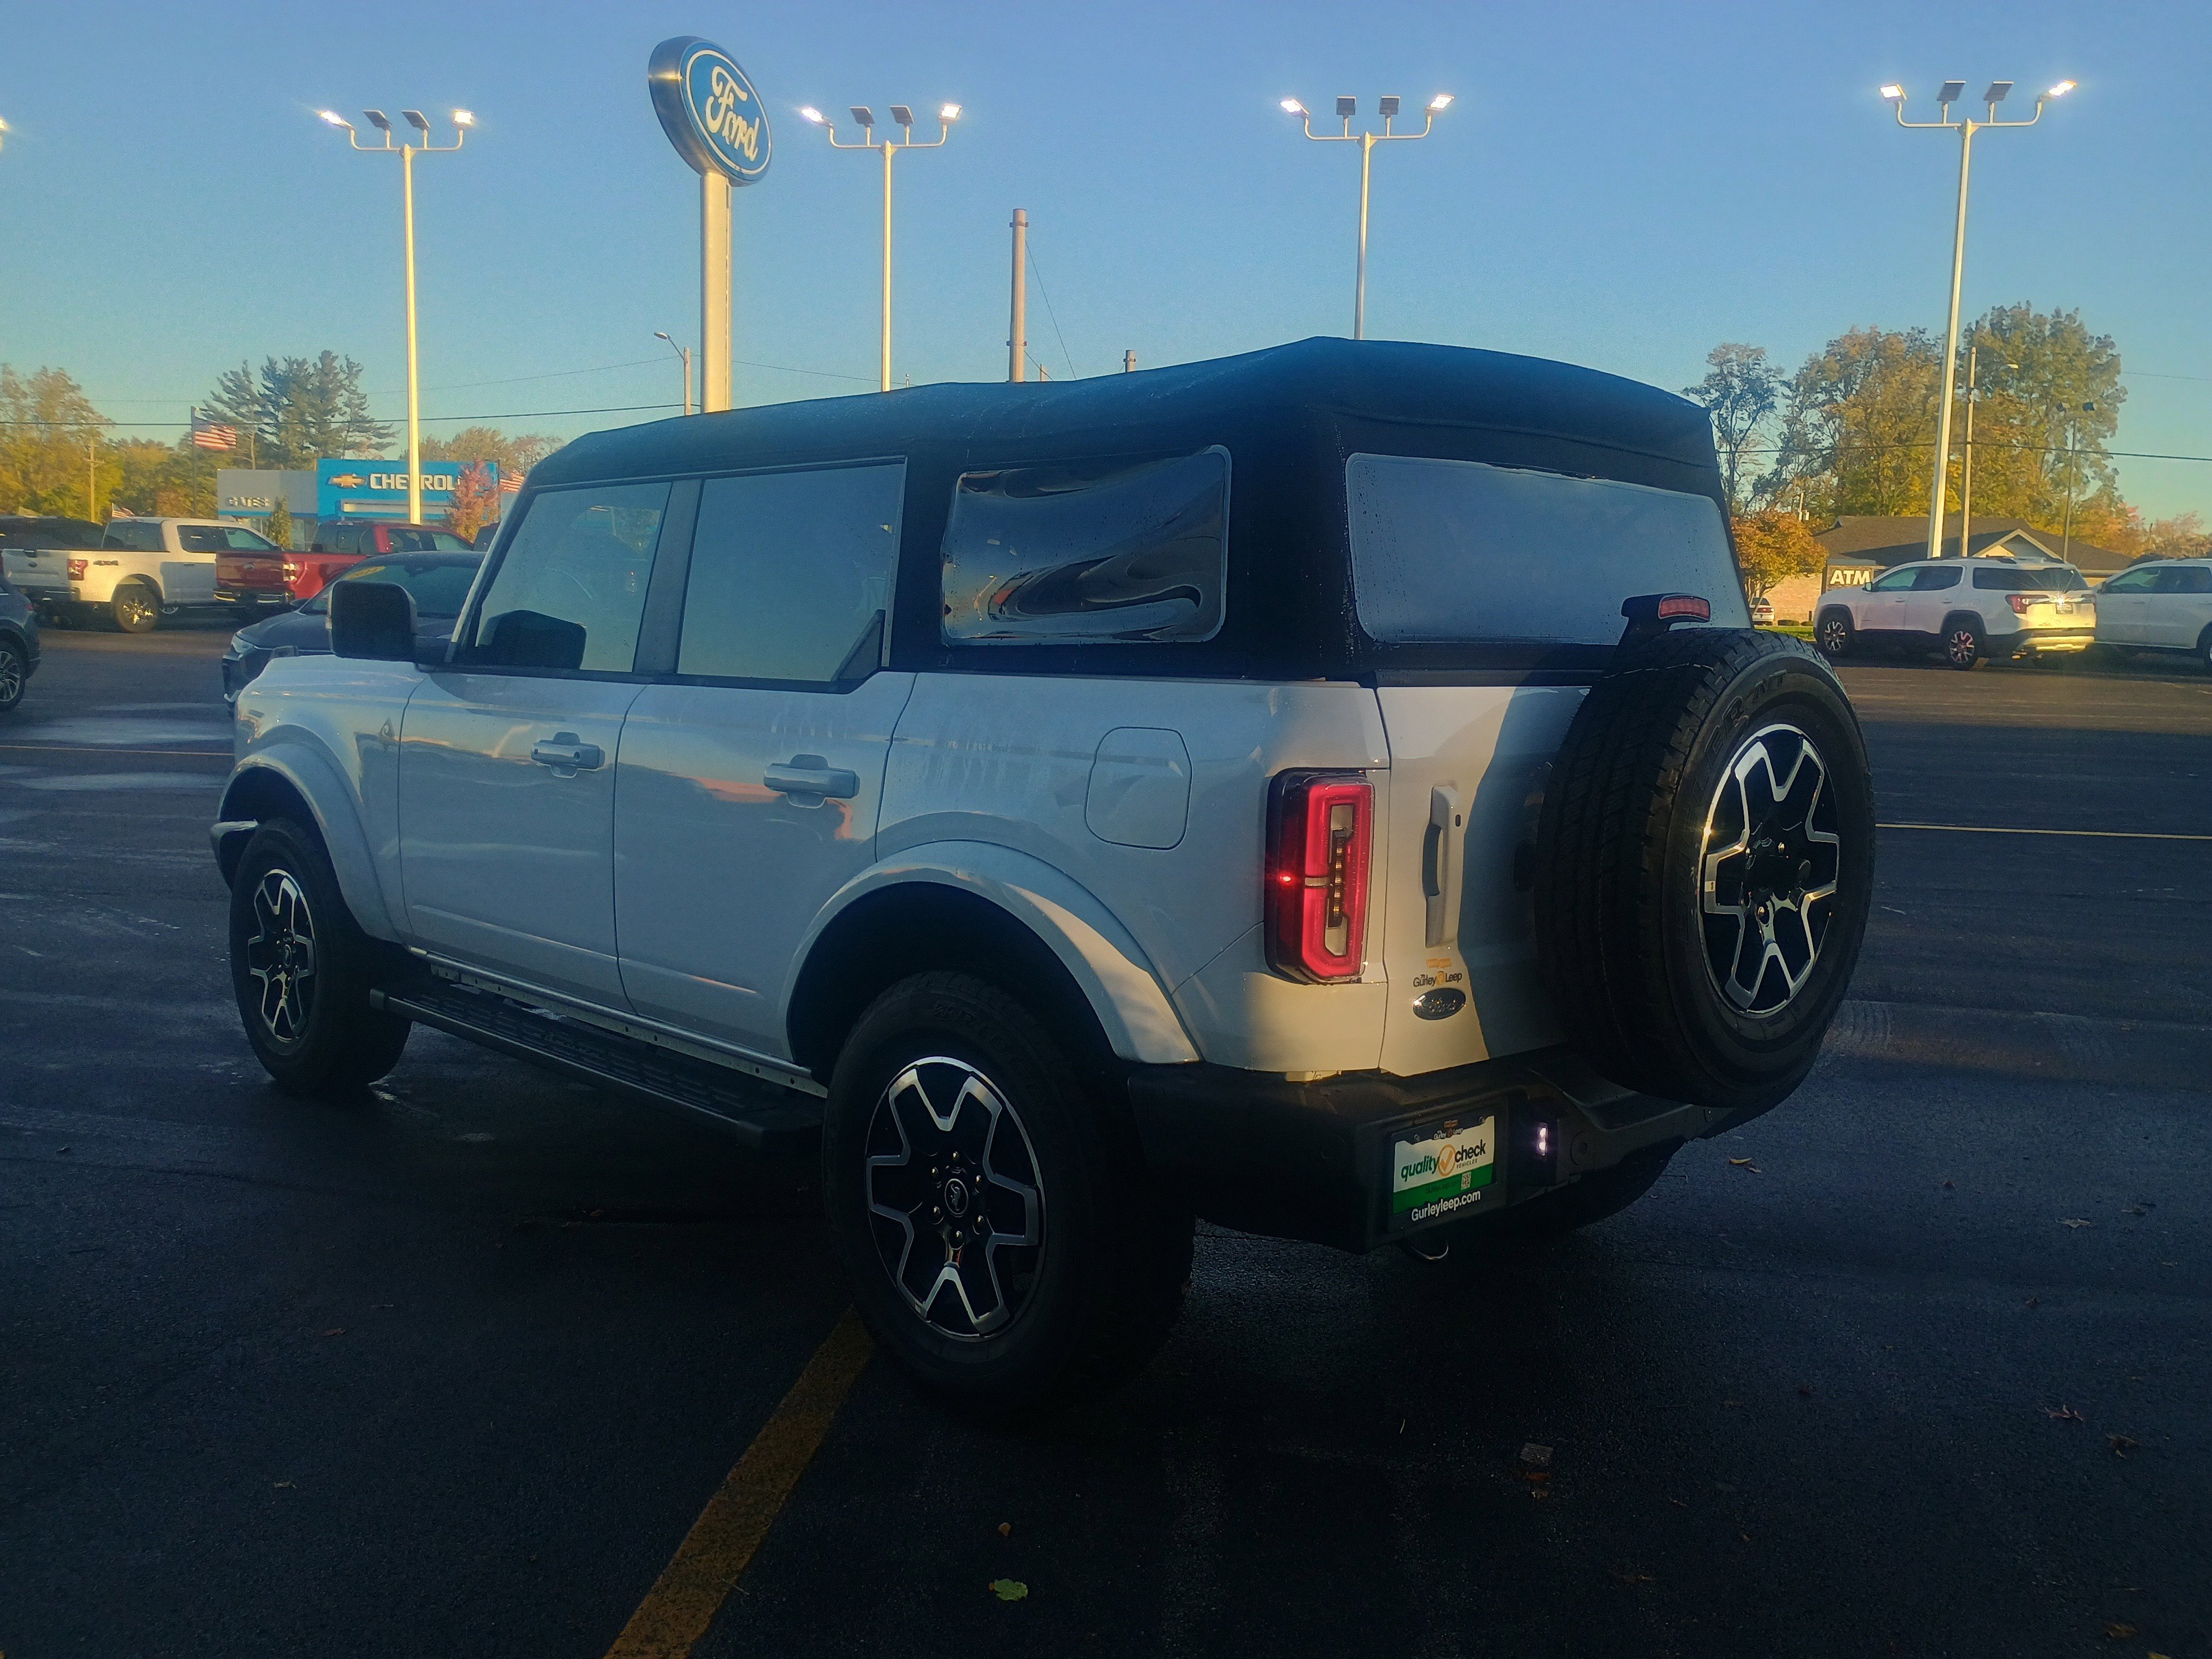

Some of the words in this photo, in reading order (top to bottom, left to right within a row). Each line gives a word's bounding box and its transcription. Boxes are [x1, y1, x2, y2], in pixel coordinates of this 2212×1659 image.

[705, 65, 760, 161] Ford
[370, 473, 478, 491] CHEROL
[1829, 570, 1871, 585] ATM
[1413, 974, 1438, 987] Gurley
[1445, 972, 1463, 983] Leep
[1400, 1155, 1440, 1182] quality
[1454, 1139, 1486, 1163] check
[1456, 1158, 1478, 1169] VEHICLES
[1411, 1190, 1481, 1222] Gurleyleep.com
